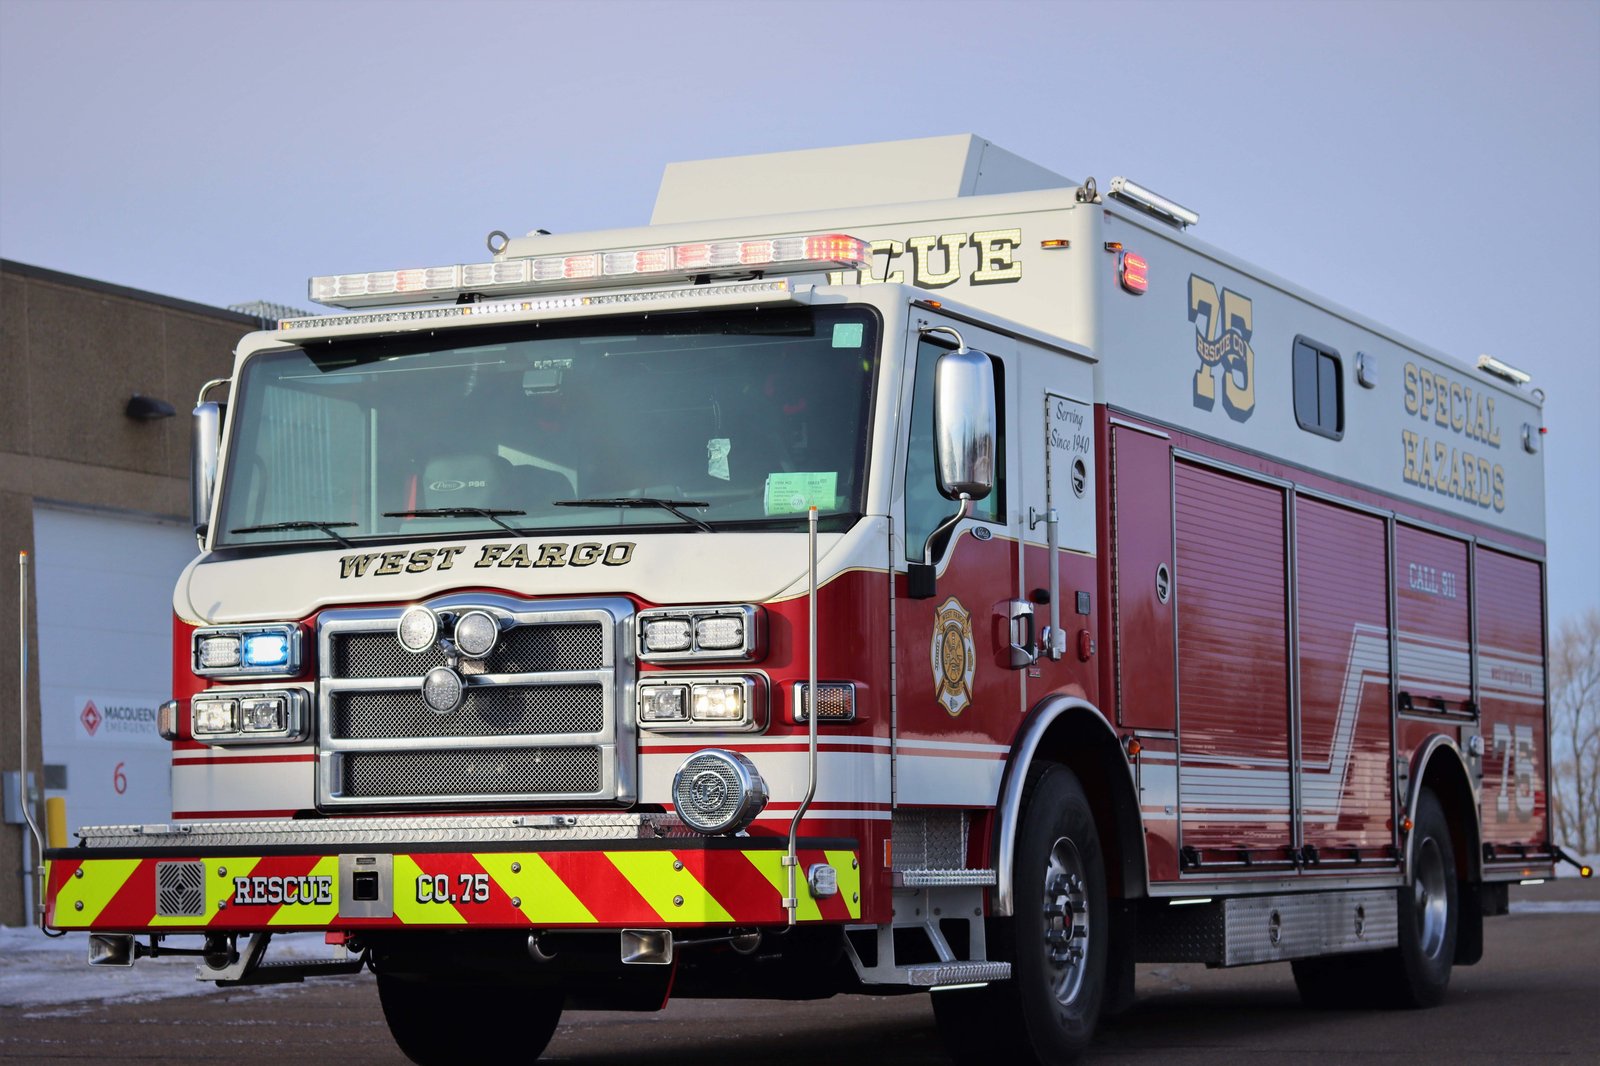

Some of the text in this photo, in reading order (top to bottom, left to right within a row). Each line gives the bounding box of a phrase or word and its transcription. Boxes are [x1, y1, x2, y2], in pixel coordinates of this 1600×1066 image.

[826, 228, 1021, 290] CUE
[1187, 272, 1255, 423] 75
[1197, 333, 1231, 363] RESCUE
[1056, 401, 1084, 431] Serving
[1404, 361, 1500, 449] SPECIAL
[1050, 428, 1090, 454] Since 1940
[1402, 429, 1505, 513] HAZARDS
[339, 541, 637, 579] WEST FARGO
[1409, 563, 1457, 598] CALL 911
[104, 706, 156, 722] MACQUEEN
[113, 761, 127, 795] 6
[1492, 723, 1535, 823] 75
[233, 875, 333, 905] RESCUE
[415, 873, 490, 904] CO.75
